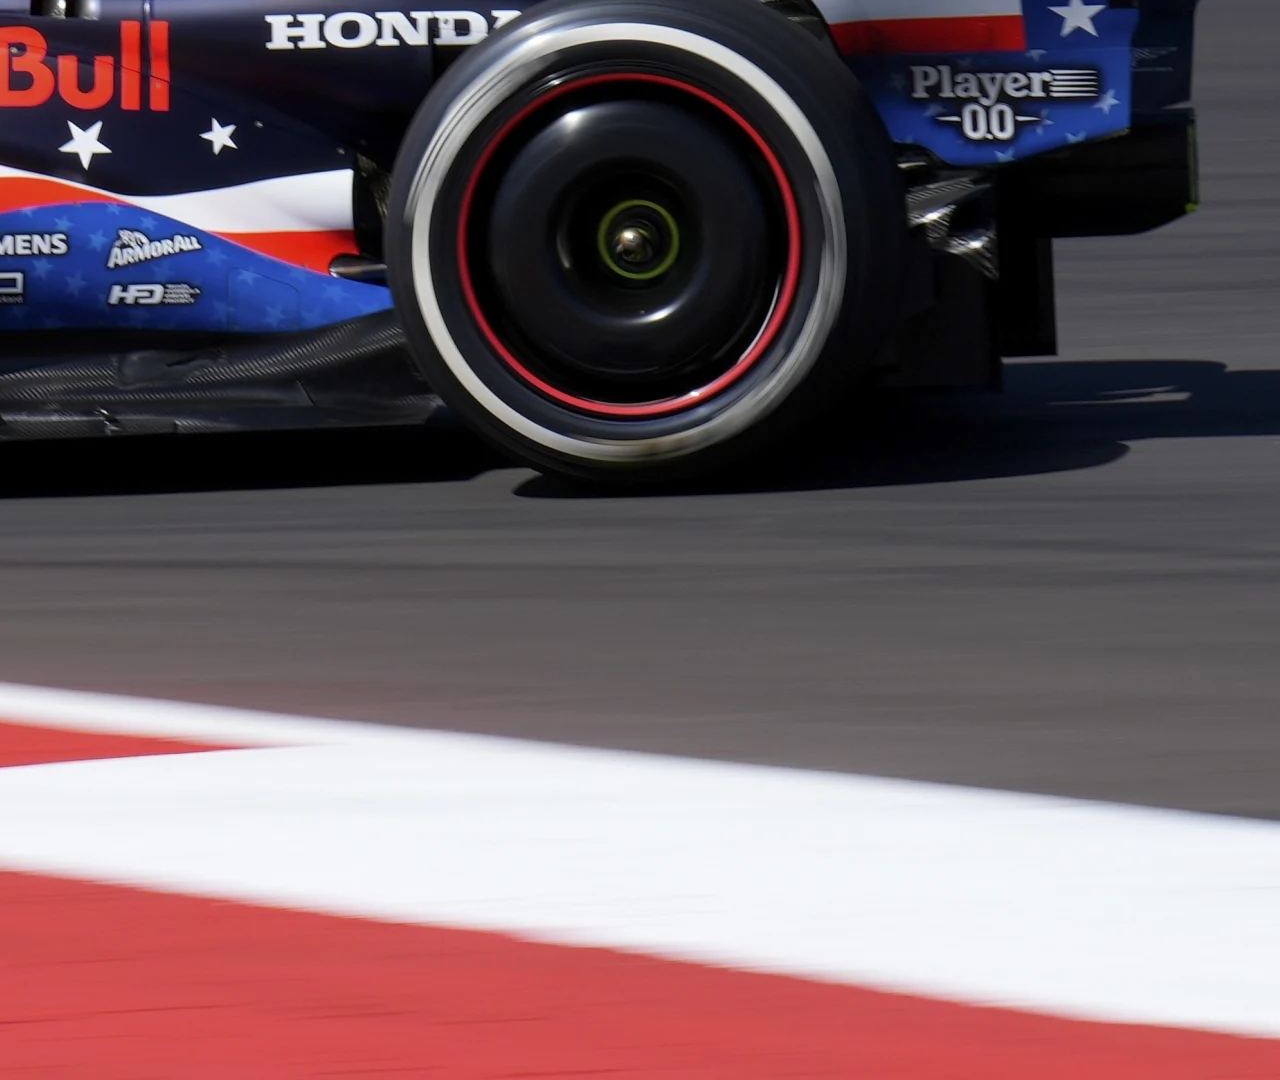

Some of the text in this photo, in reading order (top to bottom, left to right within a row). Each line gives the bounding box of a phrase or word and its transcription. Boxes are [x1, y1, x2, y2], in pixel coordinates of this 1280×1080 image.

[265, 10, 522, 50] HOND
[908, 65, 1054, 106] Player
[961, 102, 1017, 142] 0.0
